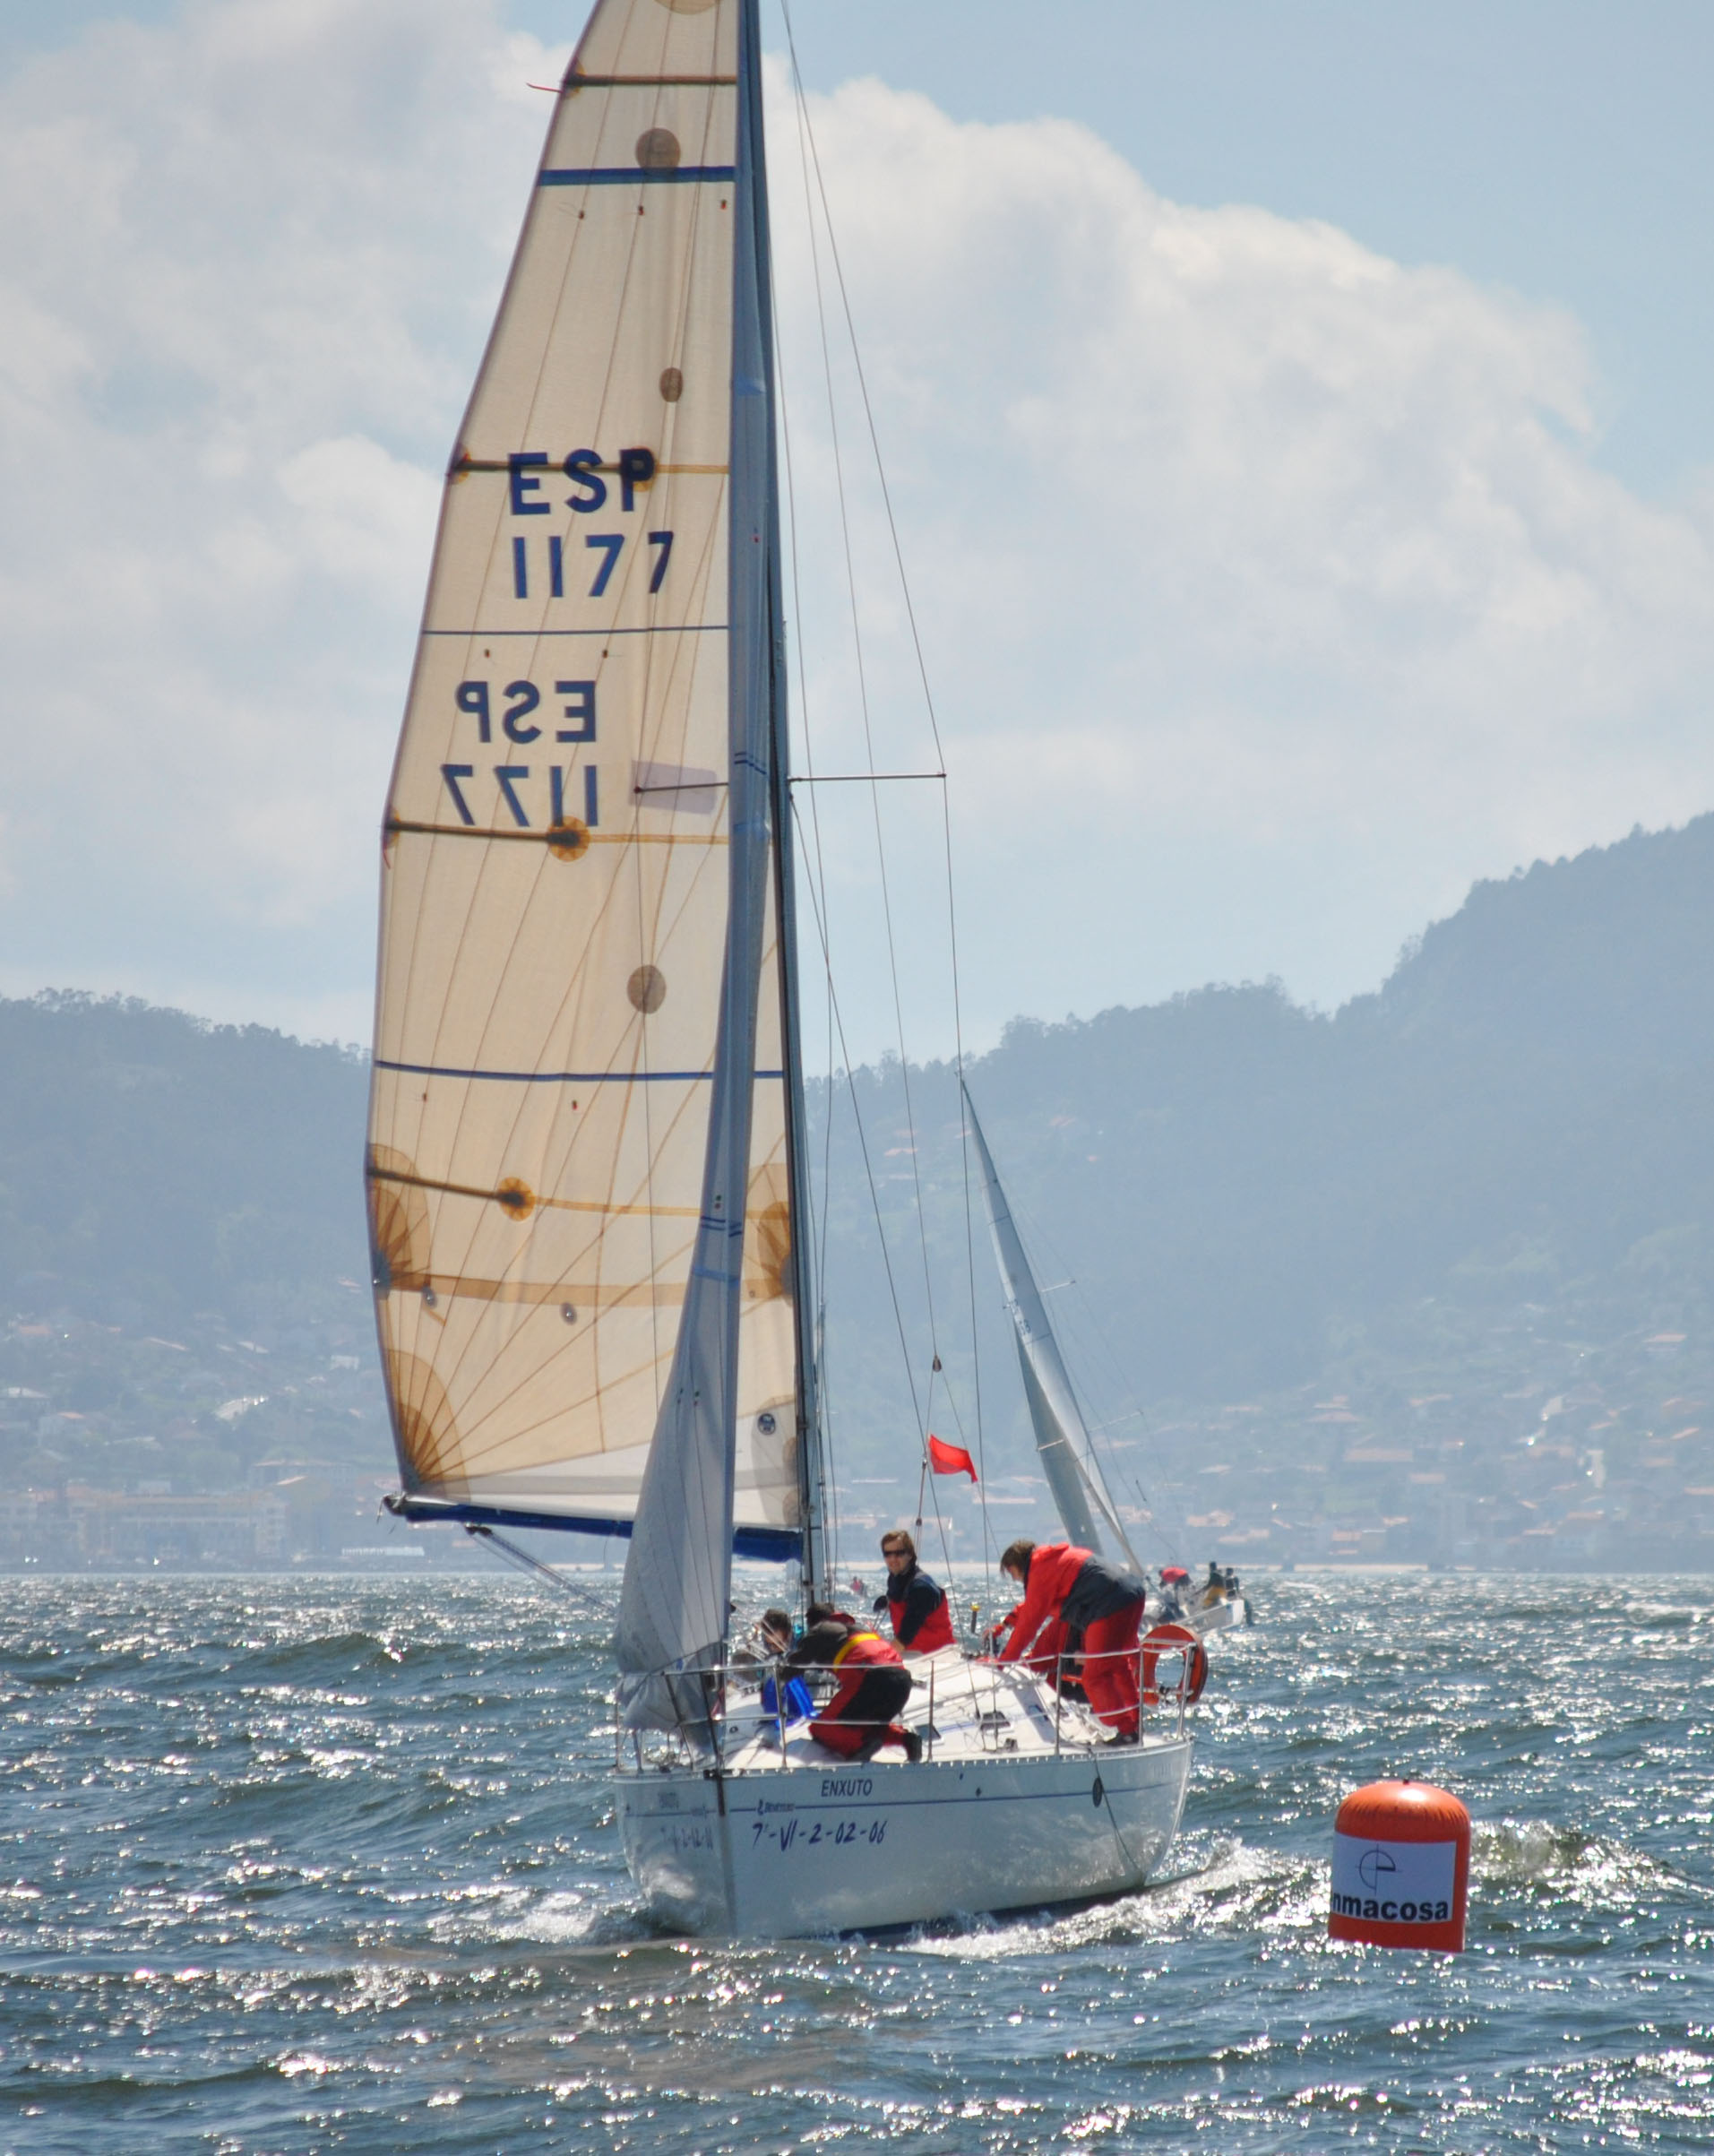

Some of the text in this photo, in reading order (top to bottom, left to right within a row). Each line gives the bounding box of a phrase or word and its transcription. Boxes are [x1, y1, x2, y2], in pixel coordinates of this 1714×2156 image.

[508, 448, 656, 515] ESP
[512, 530, 674, 599] 1177
[821, 1779, 873, 1798] ENXUTO
